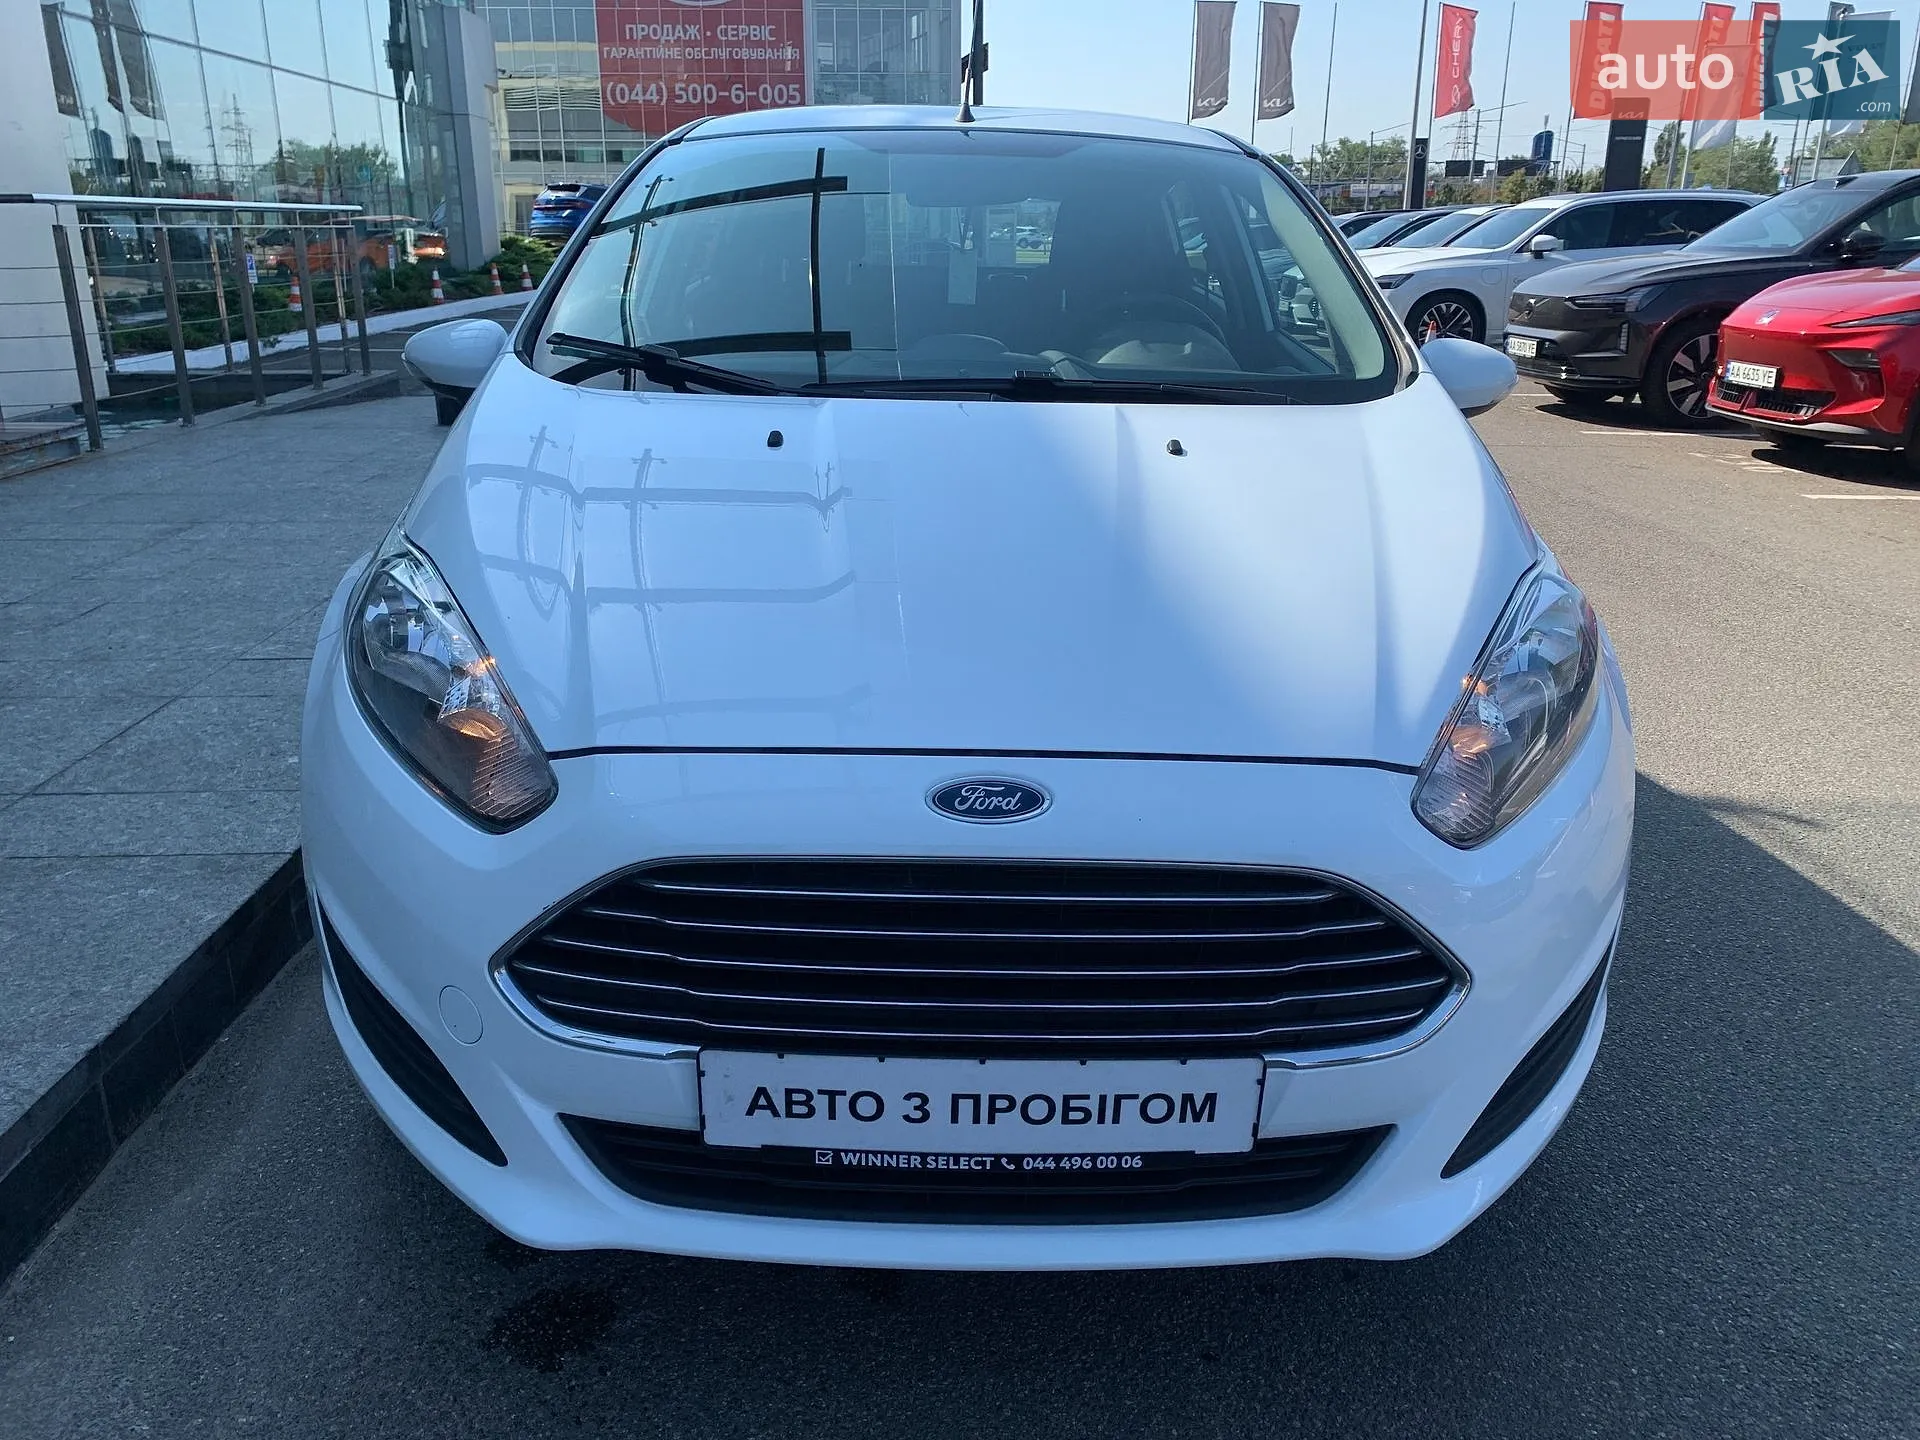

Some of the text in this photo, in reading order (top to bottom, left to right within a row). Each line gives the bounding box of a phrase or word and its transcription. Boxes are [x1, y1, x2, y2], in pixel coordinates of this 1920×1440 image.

[625, 23, 777, 44] ПРОДАЖ СЕРВІС
[1452, 12, 1464, 79] CHERY
[603, 44, 800, 60] ГАРАНТІЙНЕ ОБСЛУГОВУВАННЯ
[606, 81, 801, 106] (044) 500-6-005
[954, 785, 1022, 811] Ford
[745, 1086, 885, 1122] АВТО
[951, 1092, 1218, 1126] ПРОБІГОМ
[840, 1151, 1143, 1171] WINNER SELECT 044 496 00 06
